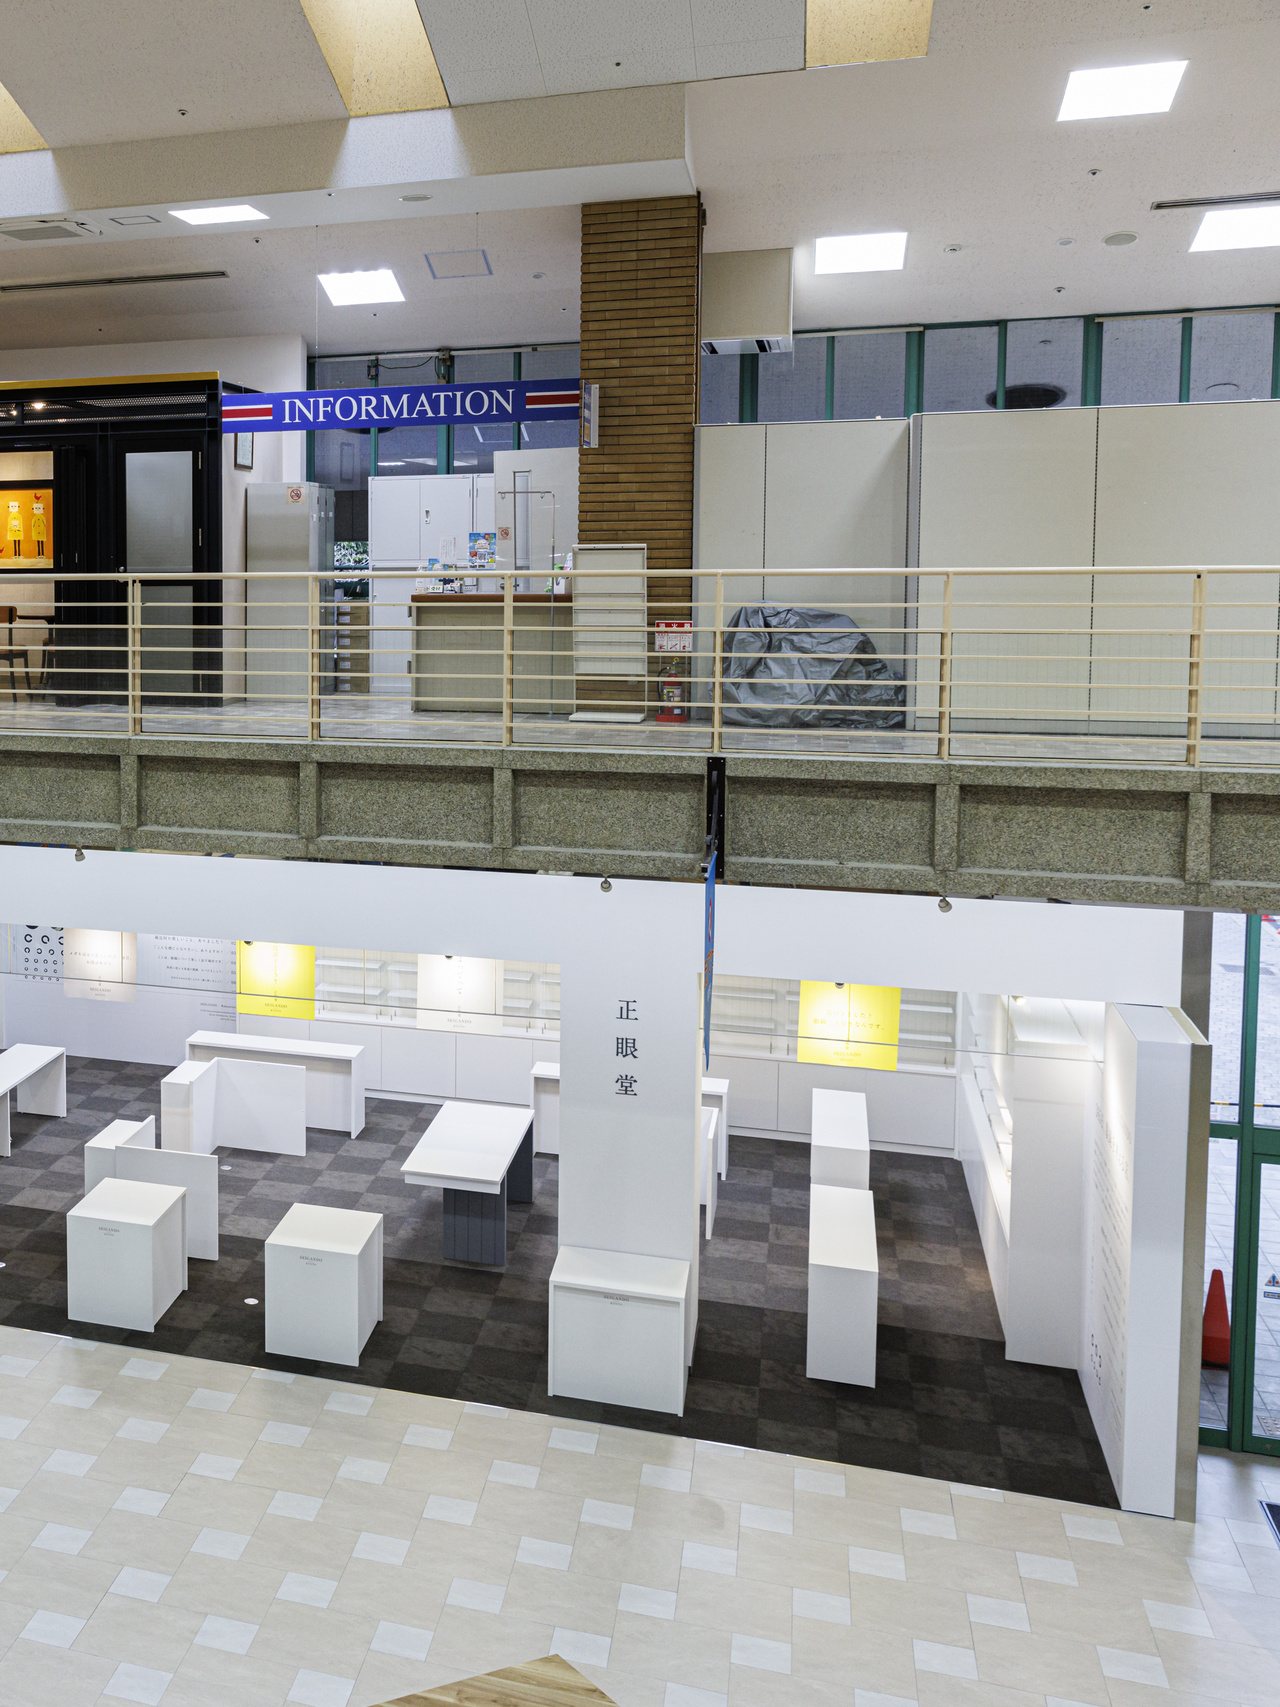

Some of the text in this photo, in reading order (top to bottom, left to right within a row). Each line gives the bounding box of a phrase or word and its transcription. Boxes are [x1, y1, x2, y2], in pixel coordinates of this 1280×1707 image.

[281, 388, 516, 425] INFORMATION
[615, 999, 639, 1096] 正眼堂
